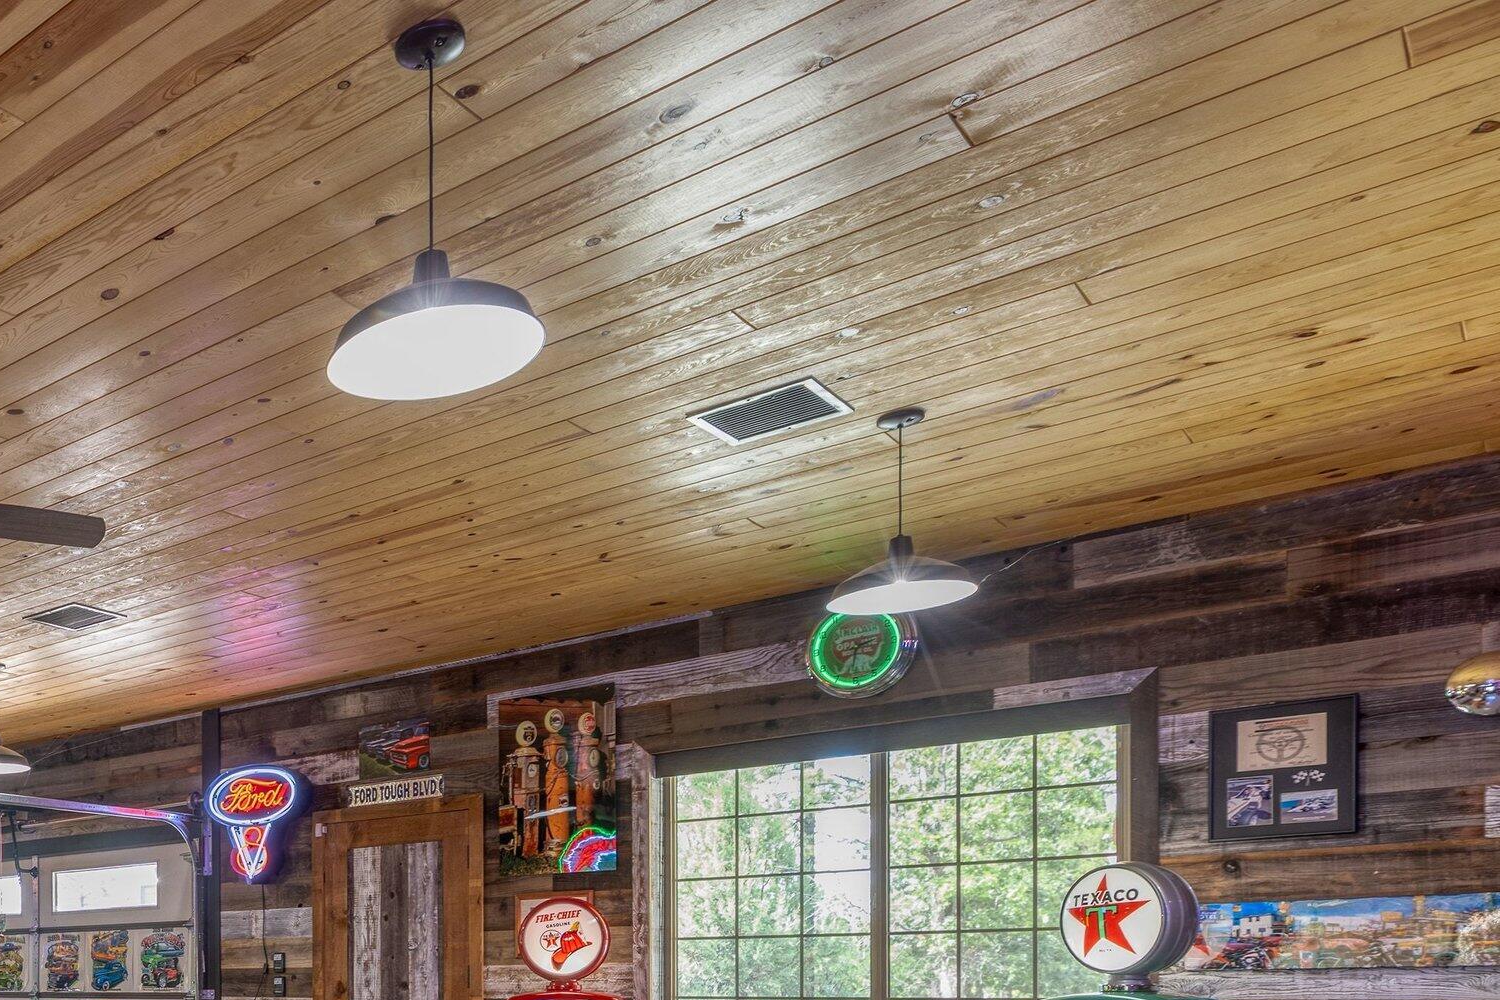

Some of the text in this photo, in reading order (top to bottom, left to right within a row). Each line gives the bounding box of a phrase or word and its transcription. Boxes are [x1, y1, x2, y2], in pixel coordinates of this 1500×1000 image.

[220, 778, 284, 812] Ford
[354, 779, 437, 804] FORD TOUGH BLVD
[1073, 888, 1140, 907] TEXACO
[535, 910, 582, 924] FIRE-CHIEF
